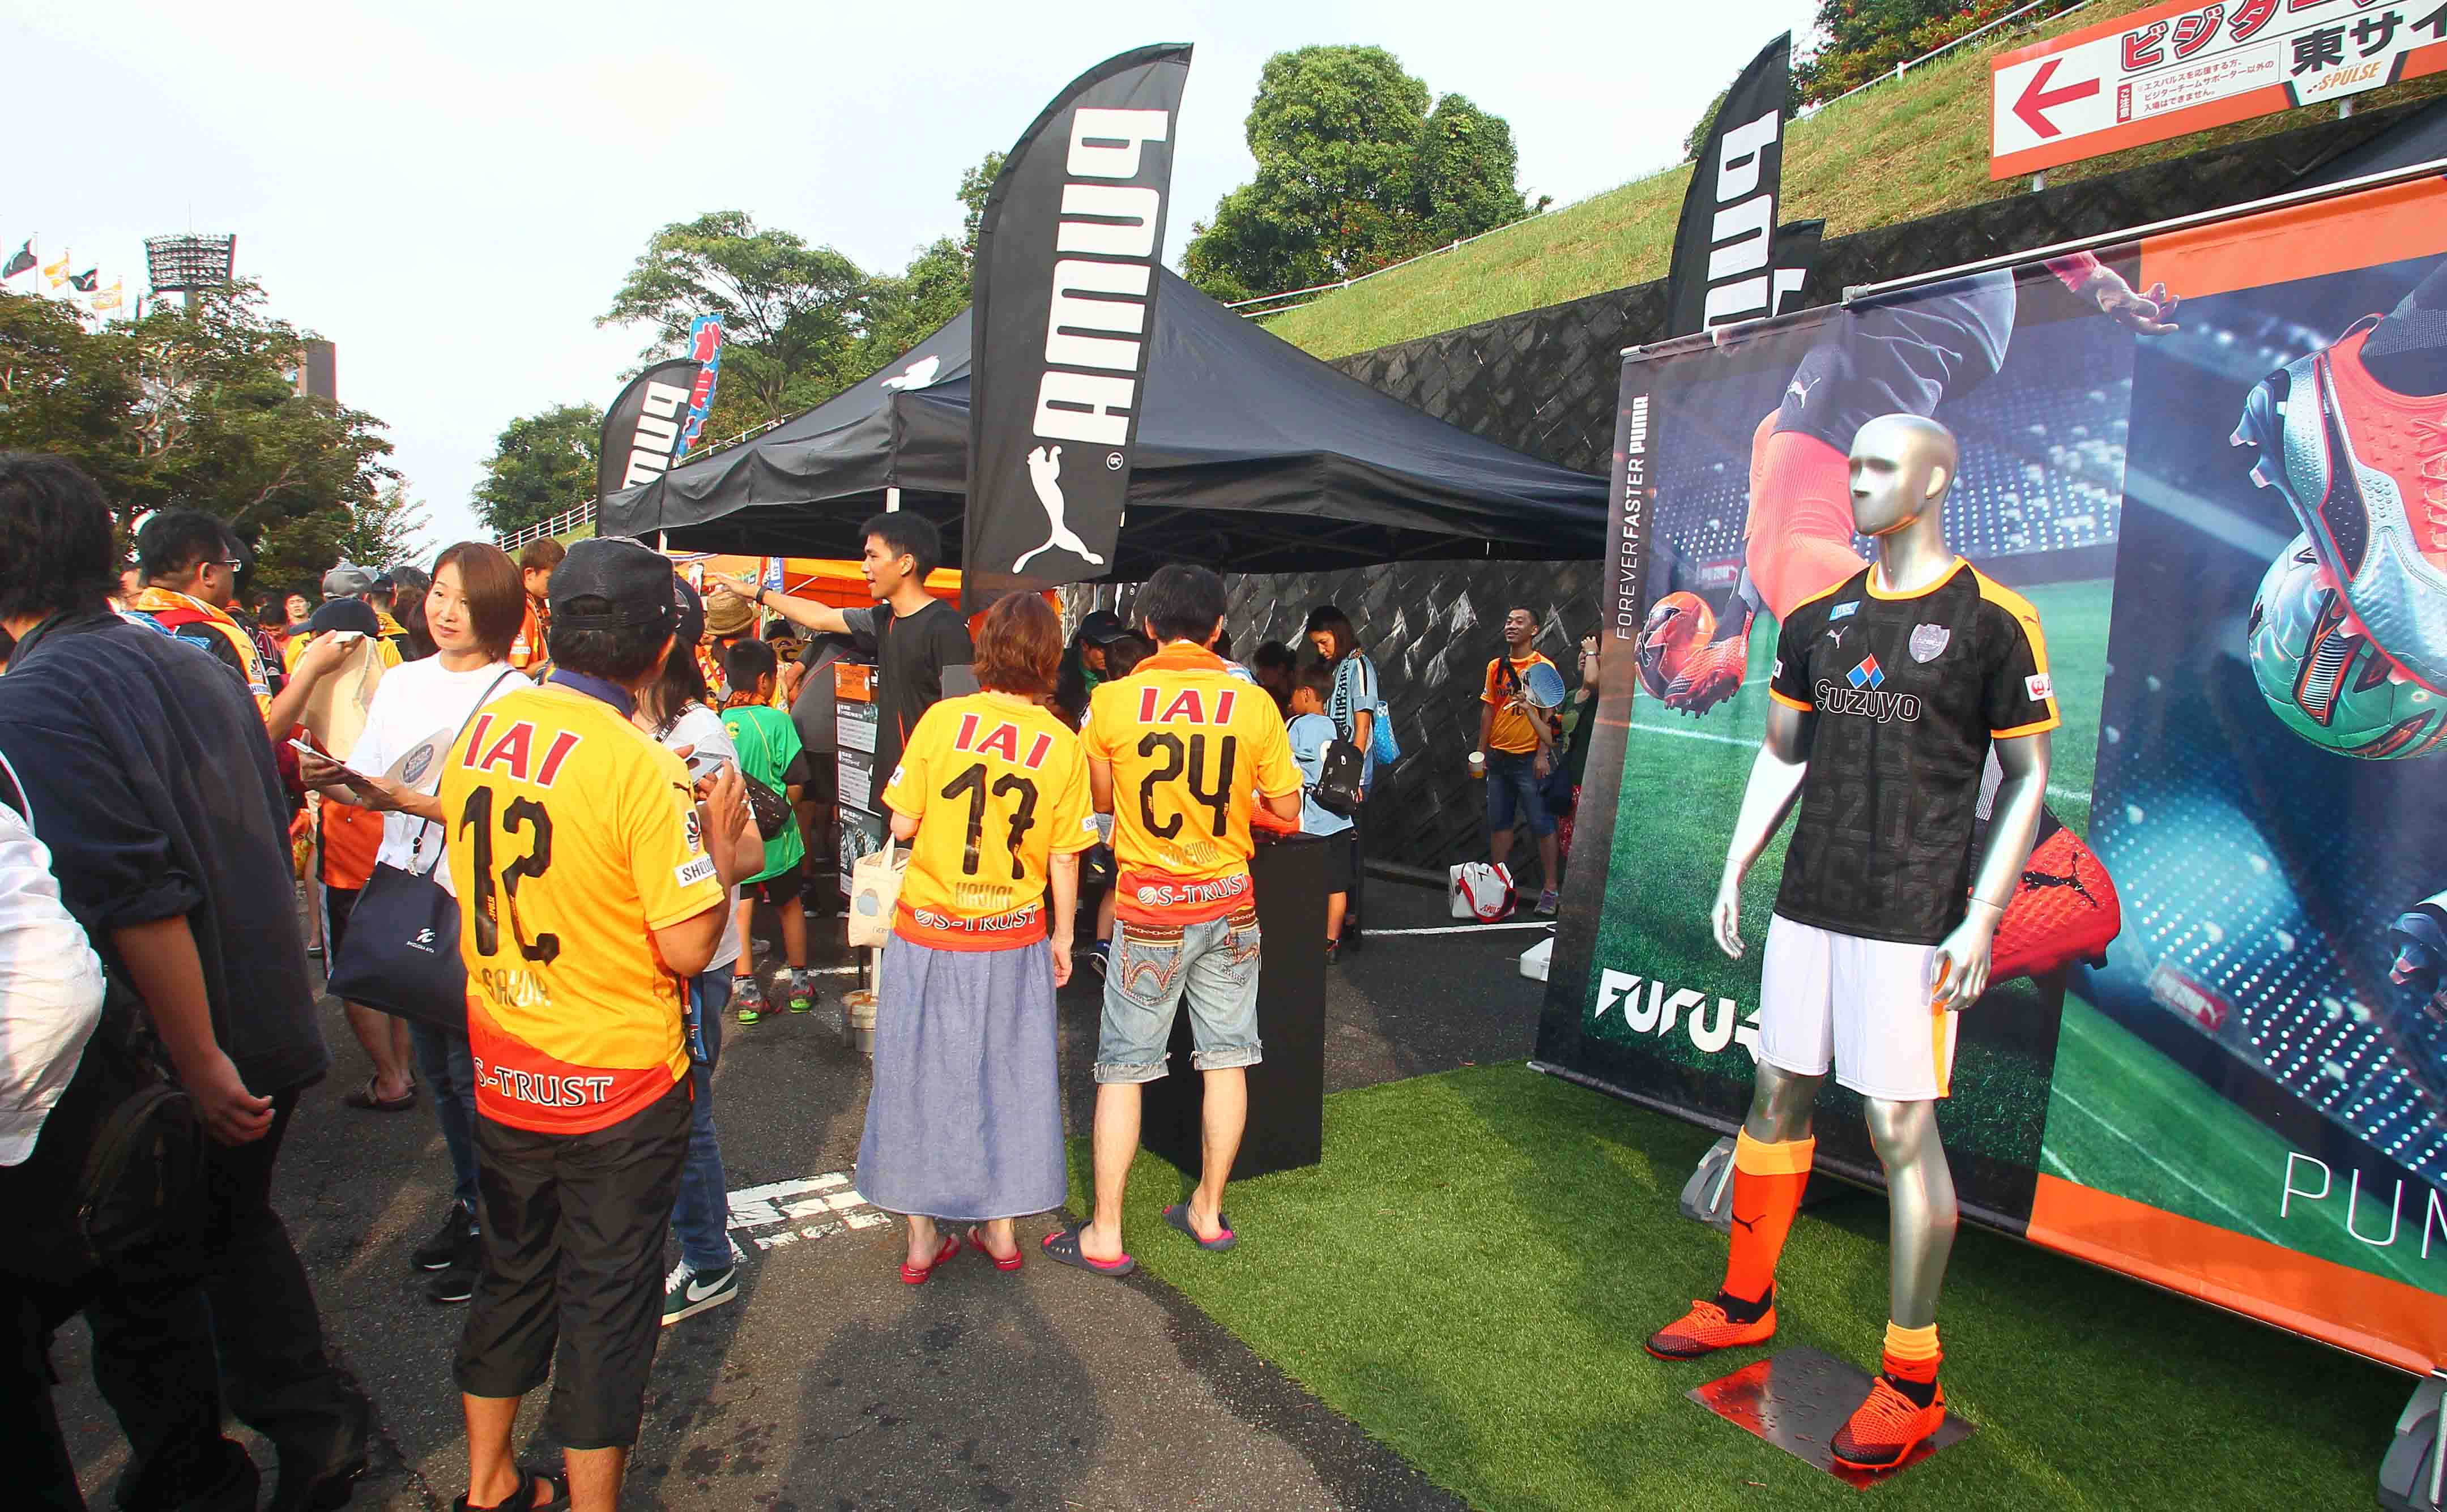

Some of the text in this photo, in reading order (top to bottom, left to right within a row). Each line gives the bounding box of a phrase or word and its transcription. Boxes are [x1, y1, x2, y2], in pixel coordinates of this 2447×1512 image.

[1138, 686, 1237, 725] IAI
[462, 712, 583, 789] IAI
[954, 712, 1054, 770] IAI
[1138, 732, 1236, 839] 24
[941, 762, 1039, 880] 17
[459, 785, 560, 966] 12
[1157, 873, 1248, 906] S-TRUST
[933, 903, 1039, 932] S-TRUST
[475, 1057, 613, 1106] S-TRUST
